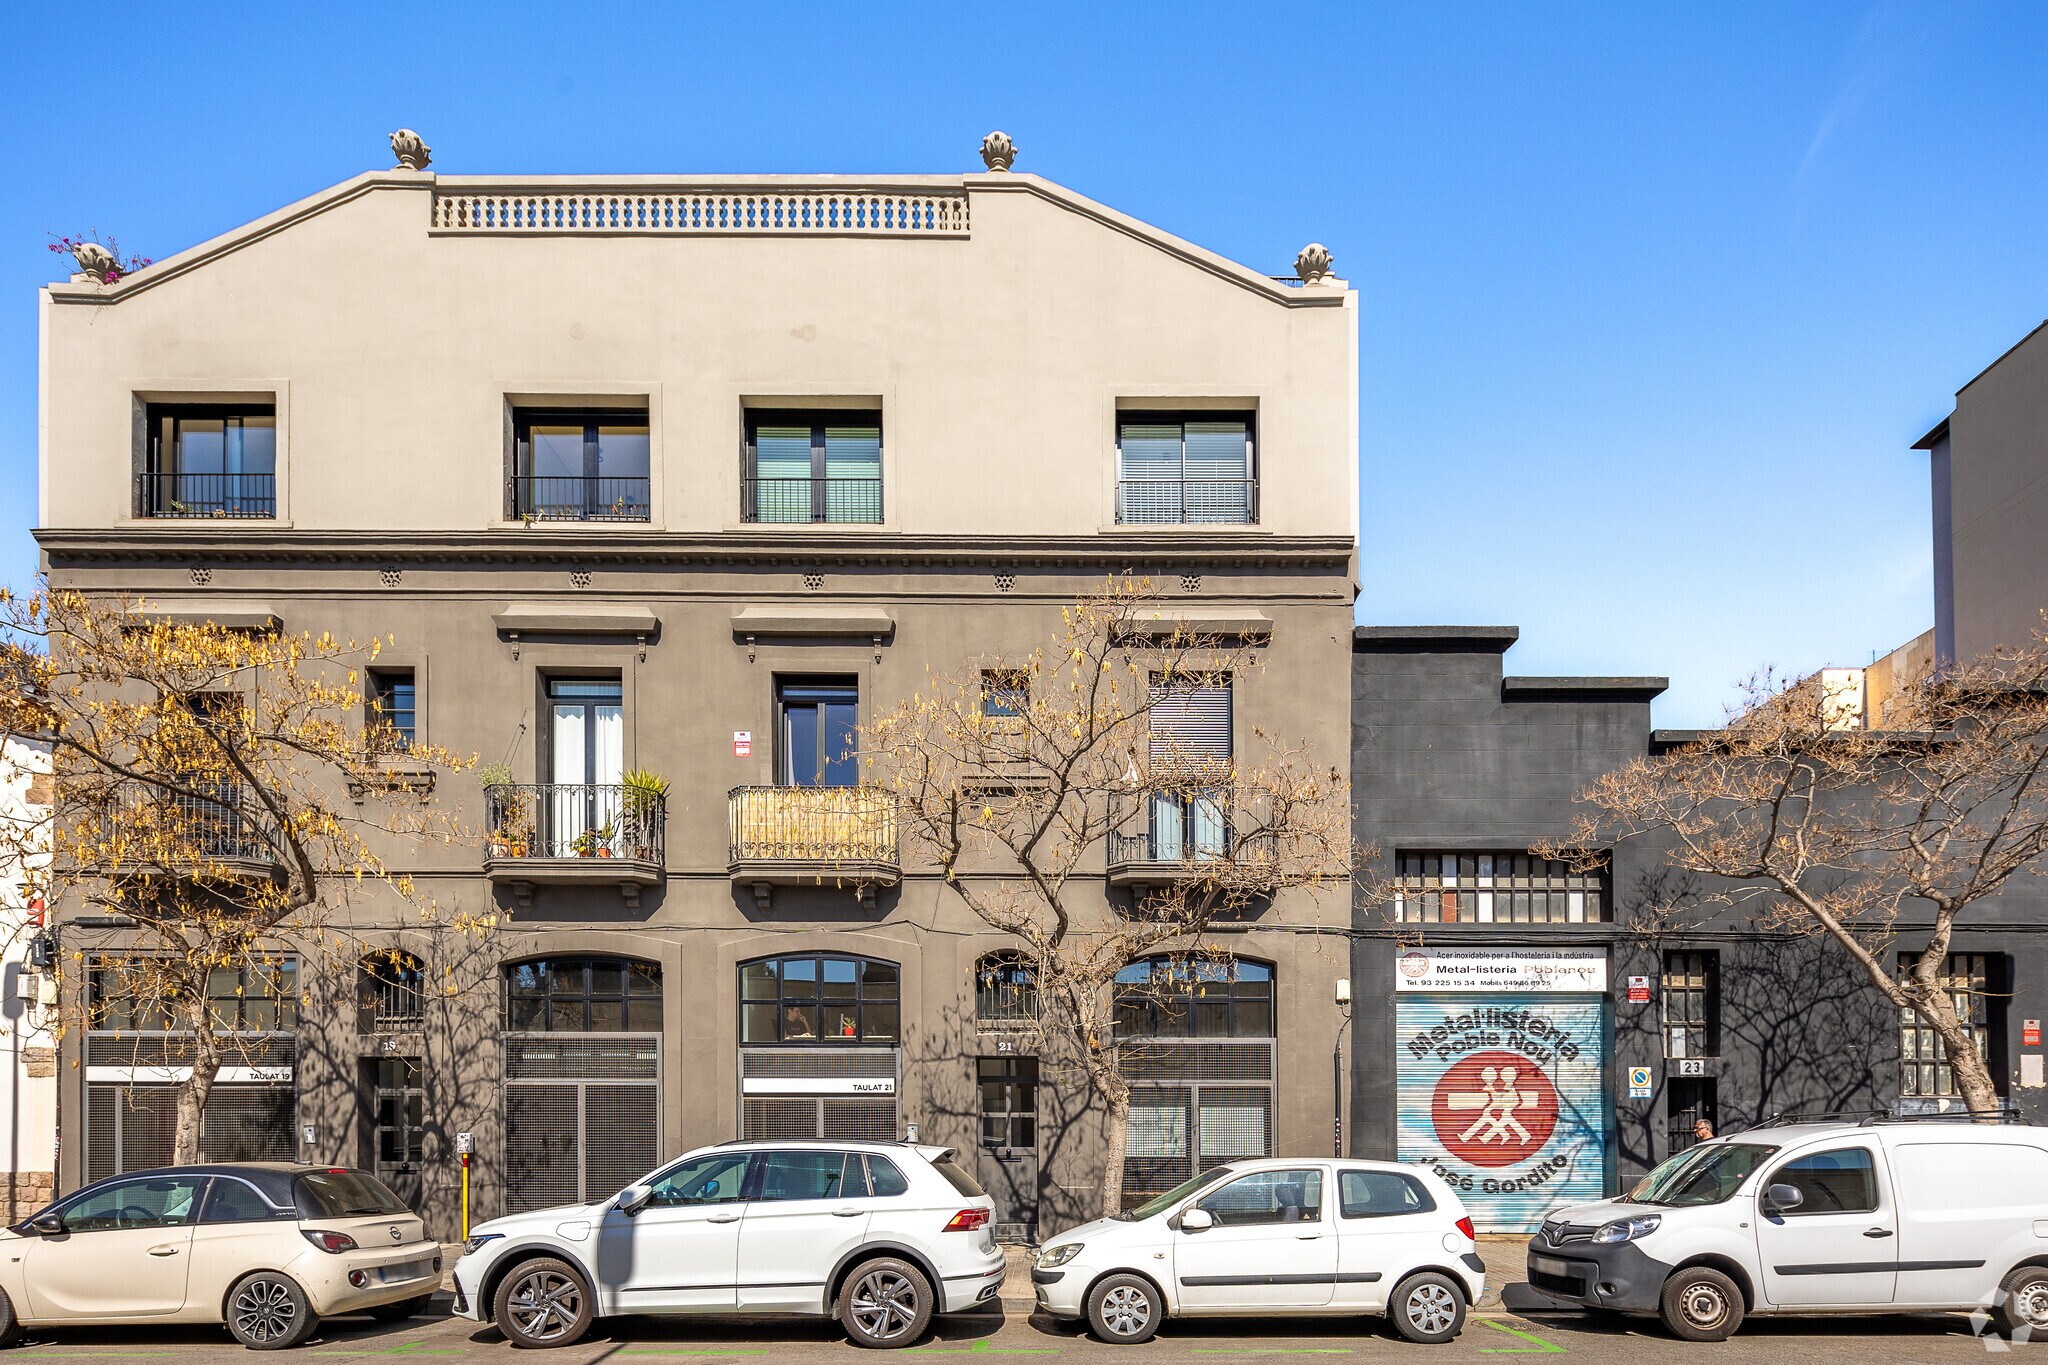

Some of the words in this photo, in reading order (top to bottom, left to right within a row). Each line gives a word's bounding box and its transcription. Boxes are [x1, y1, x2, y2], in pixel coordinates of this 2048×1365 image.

[1436, 951, 1452, 959] Acer
[1454, 951, 1489, 959] inoxidable
[1556, 951, 1562, 959] la
[1436, 965, 1516, 974] Metal-listeria
[999, 1042, 1012, 1050] 21
[1435, 1030, 1500, 1063] Poble
[1507, 1031, 1553, 1065] Nou
[1684, 1062, 1700, 1073] 23
[1482, 1154, 1568, 1194] Gordito
